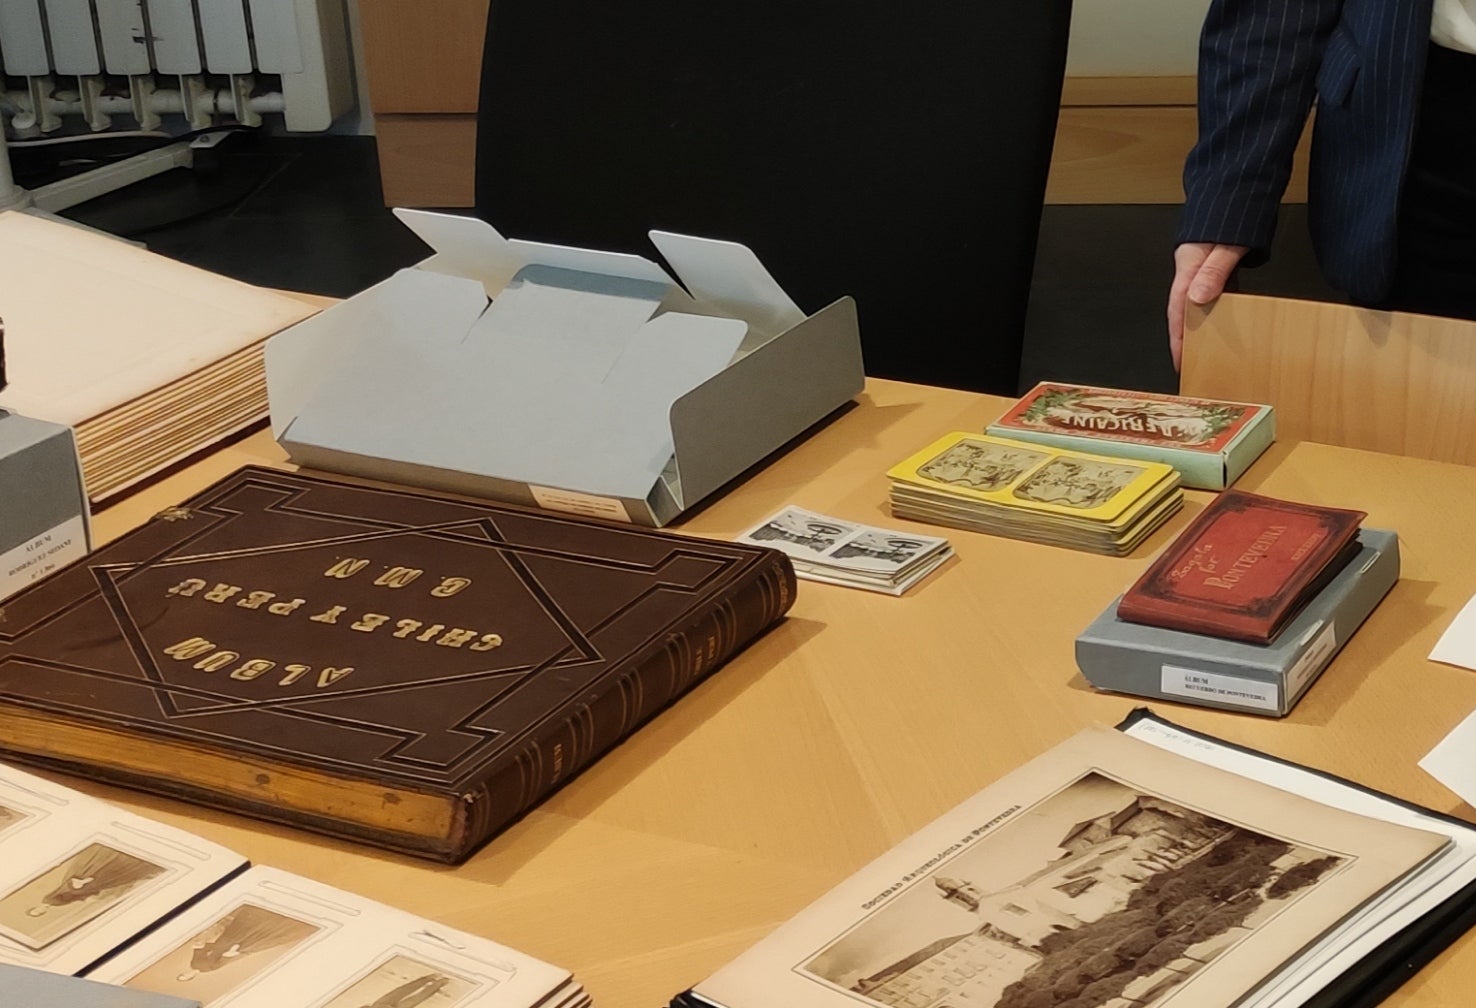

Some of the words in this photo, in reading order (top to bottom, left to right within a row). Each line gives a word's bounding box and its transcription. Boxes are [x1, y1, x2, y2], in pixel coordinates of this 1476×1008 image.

[165, 578, 306, 615] PERU
[310, 605, 347, 624] Y
[351, 613, 502, 651] CHILE
[164, 637, 354, 687] ALBUM
[861, 882, 904, 911] SOCIEDAD
[962, 835, 974, 844] DE
[972, 804, 1022, 836] PONTEVEDRA
